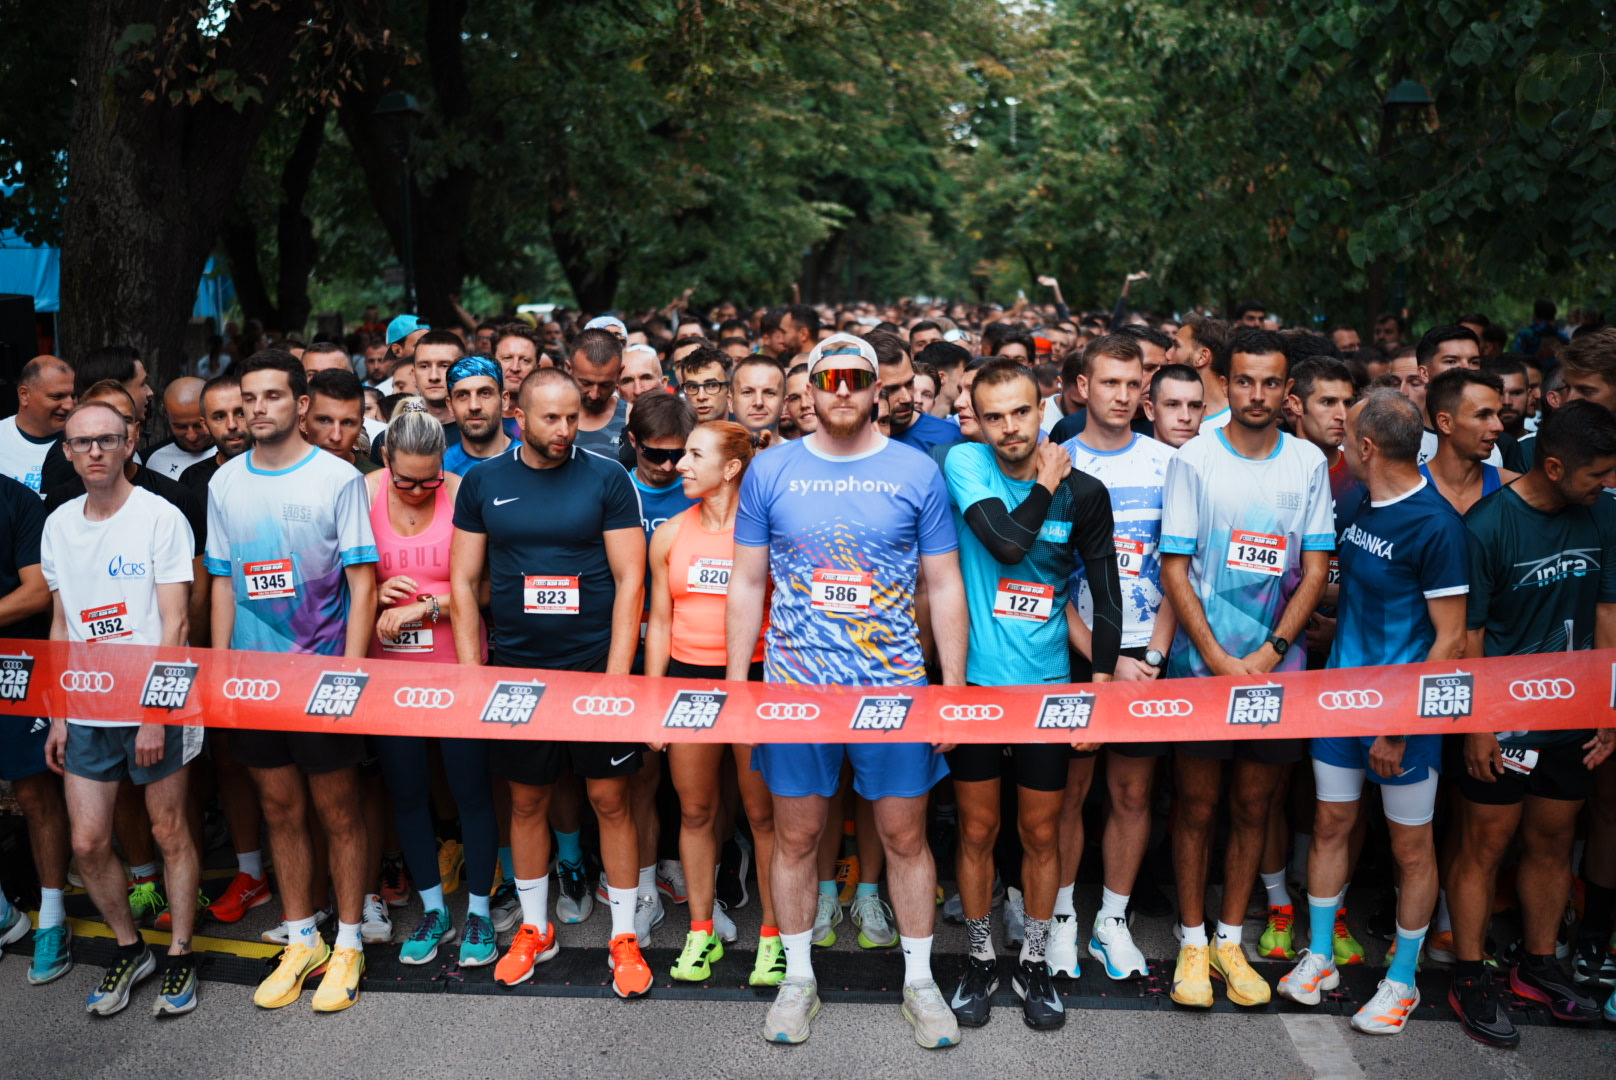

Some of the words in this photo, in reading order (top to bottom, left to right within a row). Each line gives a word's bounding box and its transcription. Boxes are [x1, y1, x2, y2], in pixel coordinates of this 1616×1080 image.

[25, 472, 42, 481] B2
[789, 475, 901, 497] symphony
[383, 548, 450, 570] OBUL
[1237, 545, 1278, 565] 1346
[122, 562, 146, 576] CRS
[700, 569, 729, 585] 820
[1537, 558, 1587, 588] infra
[252, 574, 286, 590] 1345
[536, 590, 566, 604] 823
[824, 586, 858, 602] 586
[1009, 595, 1040, 612] 127
[88, 618, 124, 636] 1352
[0, 684, 26, 699] UN
[149, 676, 190, 692] B2B
[316, 684, 360, 700] B2B
[144, 691, 186, 706] RUN
[492, 693, 538, 709] B2B
[1425, 686, 1470, 702] B2B
[310, 699, 356, 714] RUN
[673, 701, 720, 715] B2B
[1044, 704, 1090, 717] B2B
[1234, 696, 1280, 710] B2B
[1424, 700, 1470, 716] RUN
[485, 706, 532, 722] RUN
[860, 706, 906, 718] B2B
[1232, 708, 1279, 723] RUN
[667, 714, 716, 728] RUN
[856, 716, 904, 728] RUN
[1040, 716, 1088, 728] RUN
